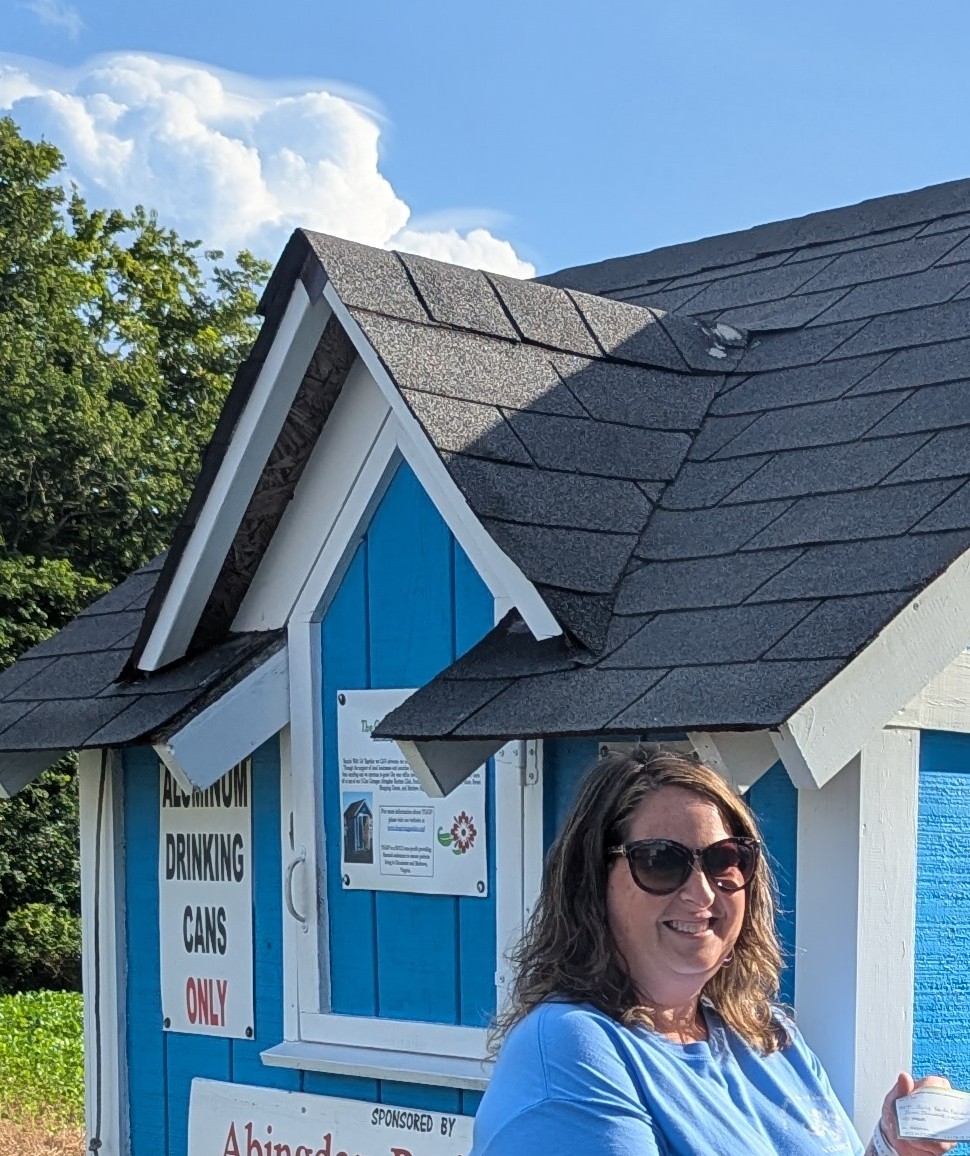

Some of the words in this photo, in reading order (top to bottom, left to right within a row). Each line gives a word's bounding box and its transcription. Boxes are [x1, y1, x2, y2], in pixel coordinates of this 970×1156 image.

[165, 833, 244, 883] DRINKING
[183, 905, 227, 955] CANS
[186, 977, 228, 1027] ONLY
[371, 1107, 433, 1133] SPONSORED
[440, 1116, 457, 1137] BY
